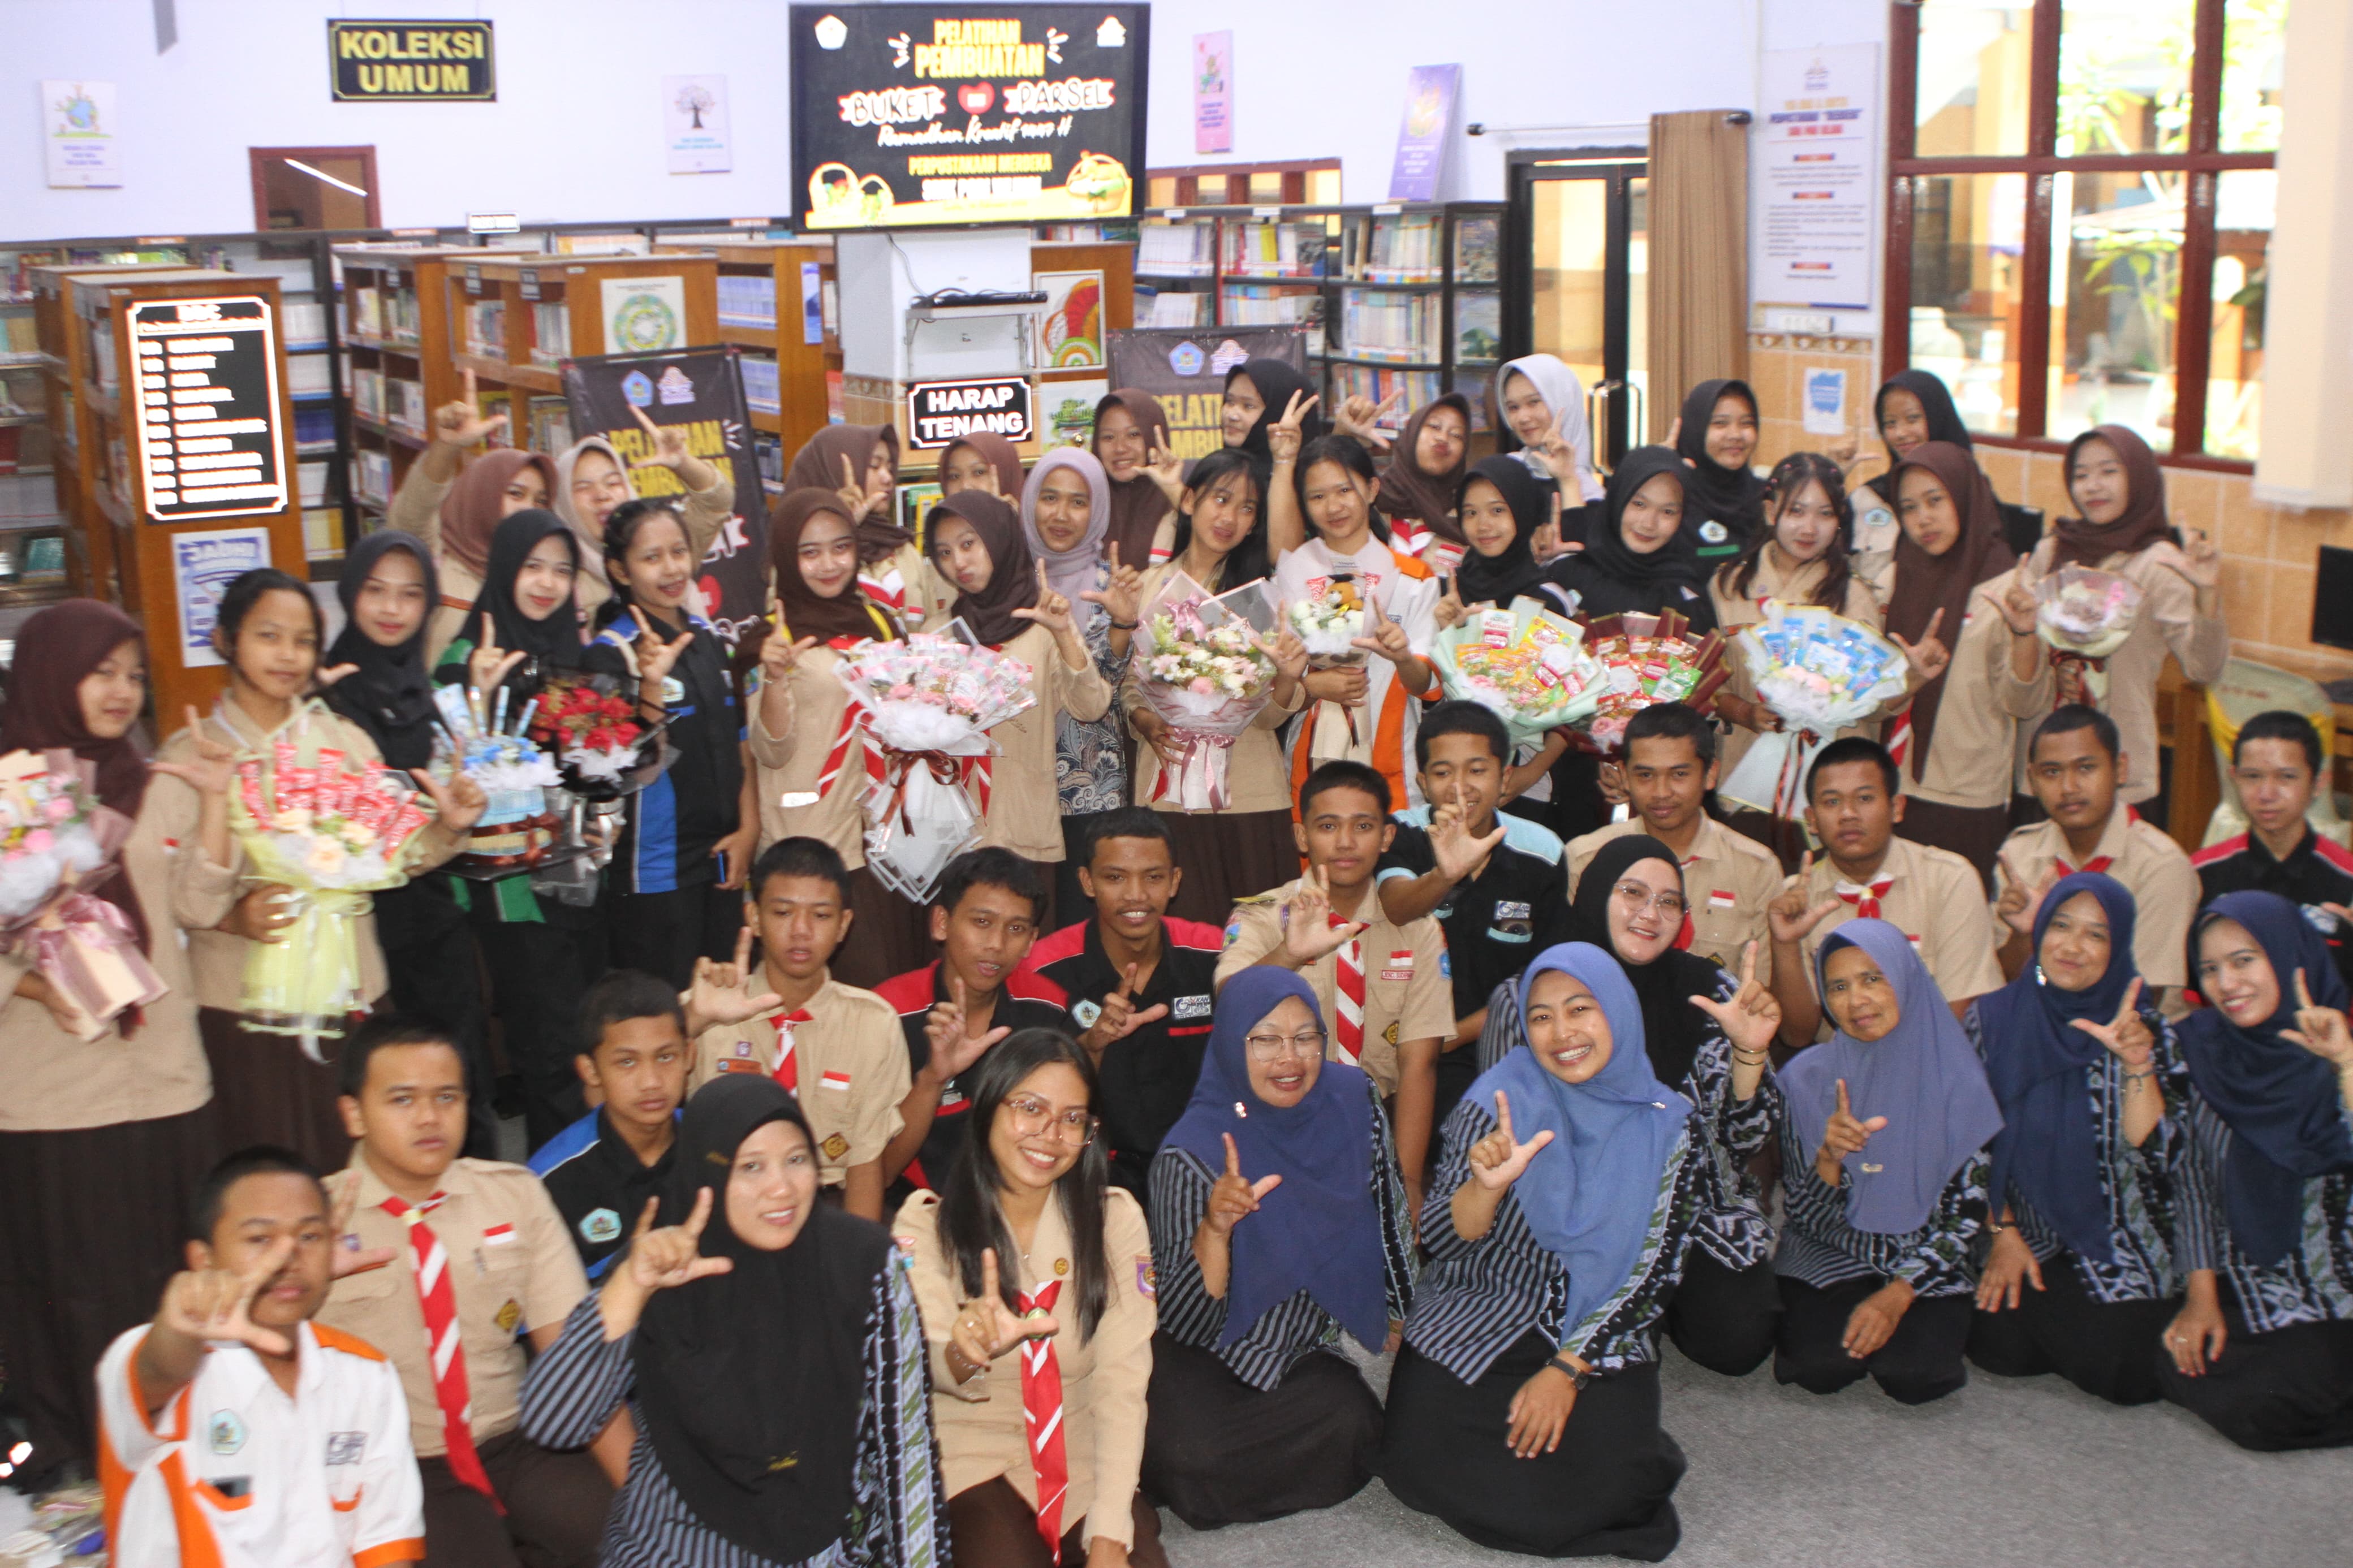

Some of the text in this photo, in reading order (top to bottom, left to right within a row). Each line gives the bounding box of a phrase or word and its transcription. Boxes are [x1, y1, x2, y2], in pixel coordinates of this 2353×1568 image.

[340, 31, 485, 59] KOLEKSI
[934, 19, 1022, 45] PELATIHAN
[914, 42, 1045, 78] PEMBUATAN
[358, 64, 470, 93] UMUM
[852, 89, 934, 122] BUKET
[1020, 83, 1107, 111] PARSEL
[878, 124, 964, 147] Ramadhan
[965, 115, 1022, 144] Kreatif
[908, 152, 1053, 176] PERPUSTAKAAN MERDEKA
[928, 386, 1014, 412] HARAP
[1152, 394, 1223, 427] ELATI
[919, 412, 1024, 439] TENANG
